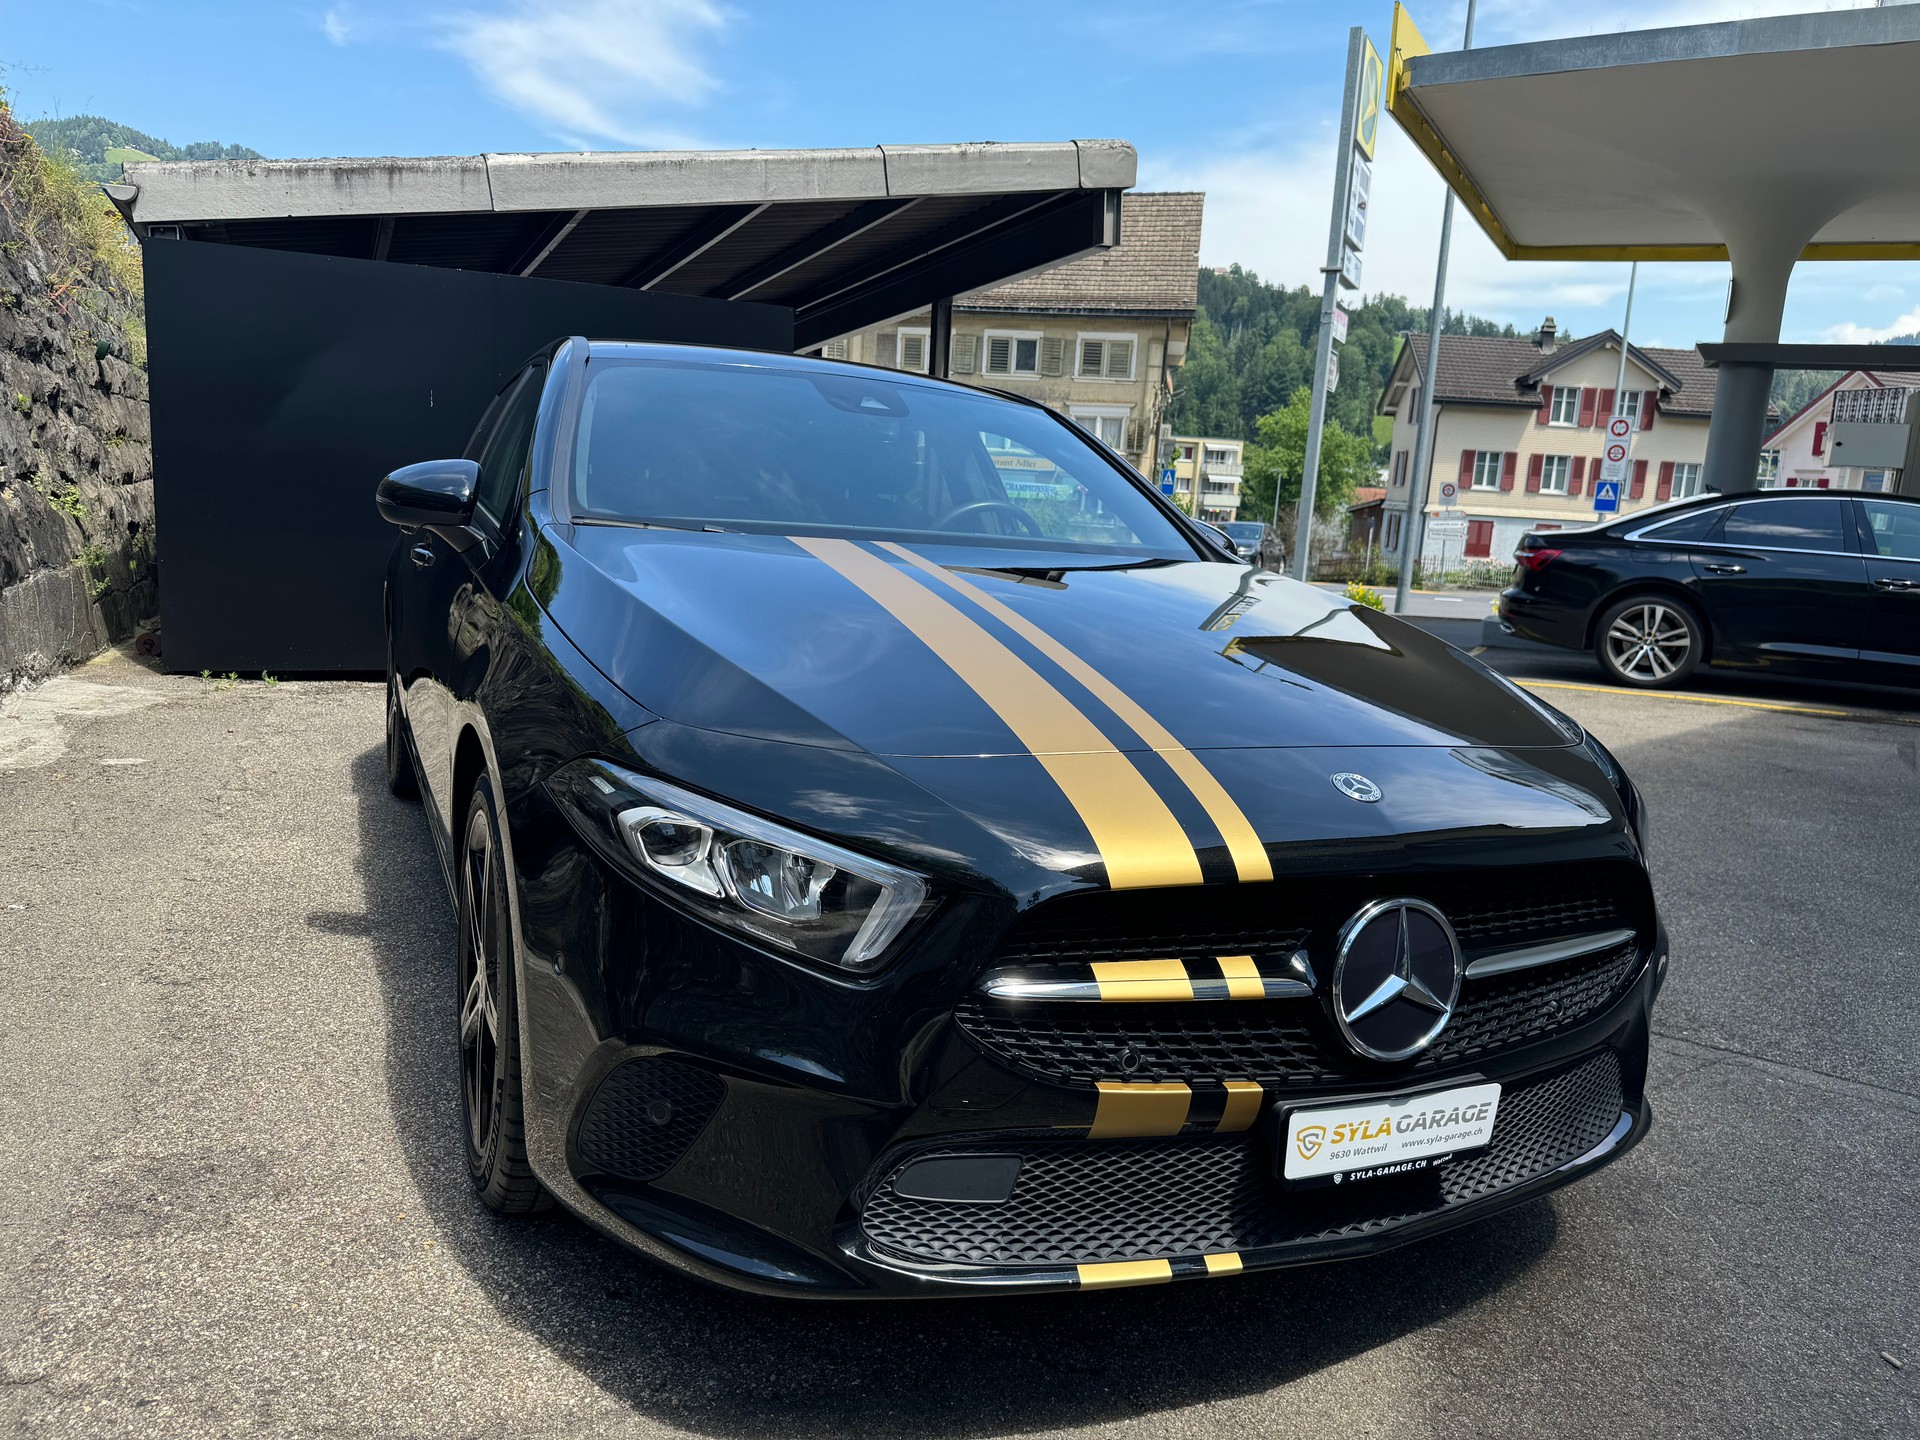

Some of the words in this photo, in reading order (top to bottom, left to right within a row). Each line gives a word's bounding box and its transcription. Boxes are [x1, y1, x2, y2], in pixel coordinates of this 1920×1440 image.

[1015, 459, 1036, 468] Adler
[1330, 1117, 1391, 1144] SYLA
[1396, 1102, 1492, 1134] GARAGE
[1329, 1149, 1351, 1160] 9630
[1353, 1143, 1388, 1157] Wattwil
[1401, 1127, 1483, 1148] www.syla-garage.ch
[1350, 1160, 1427, 1181] SYLA-GARAGE.CH
[1433, 1153, 1453, 1166] Wattwil
